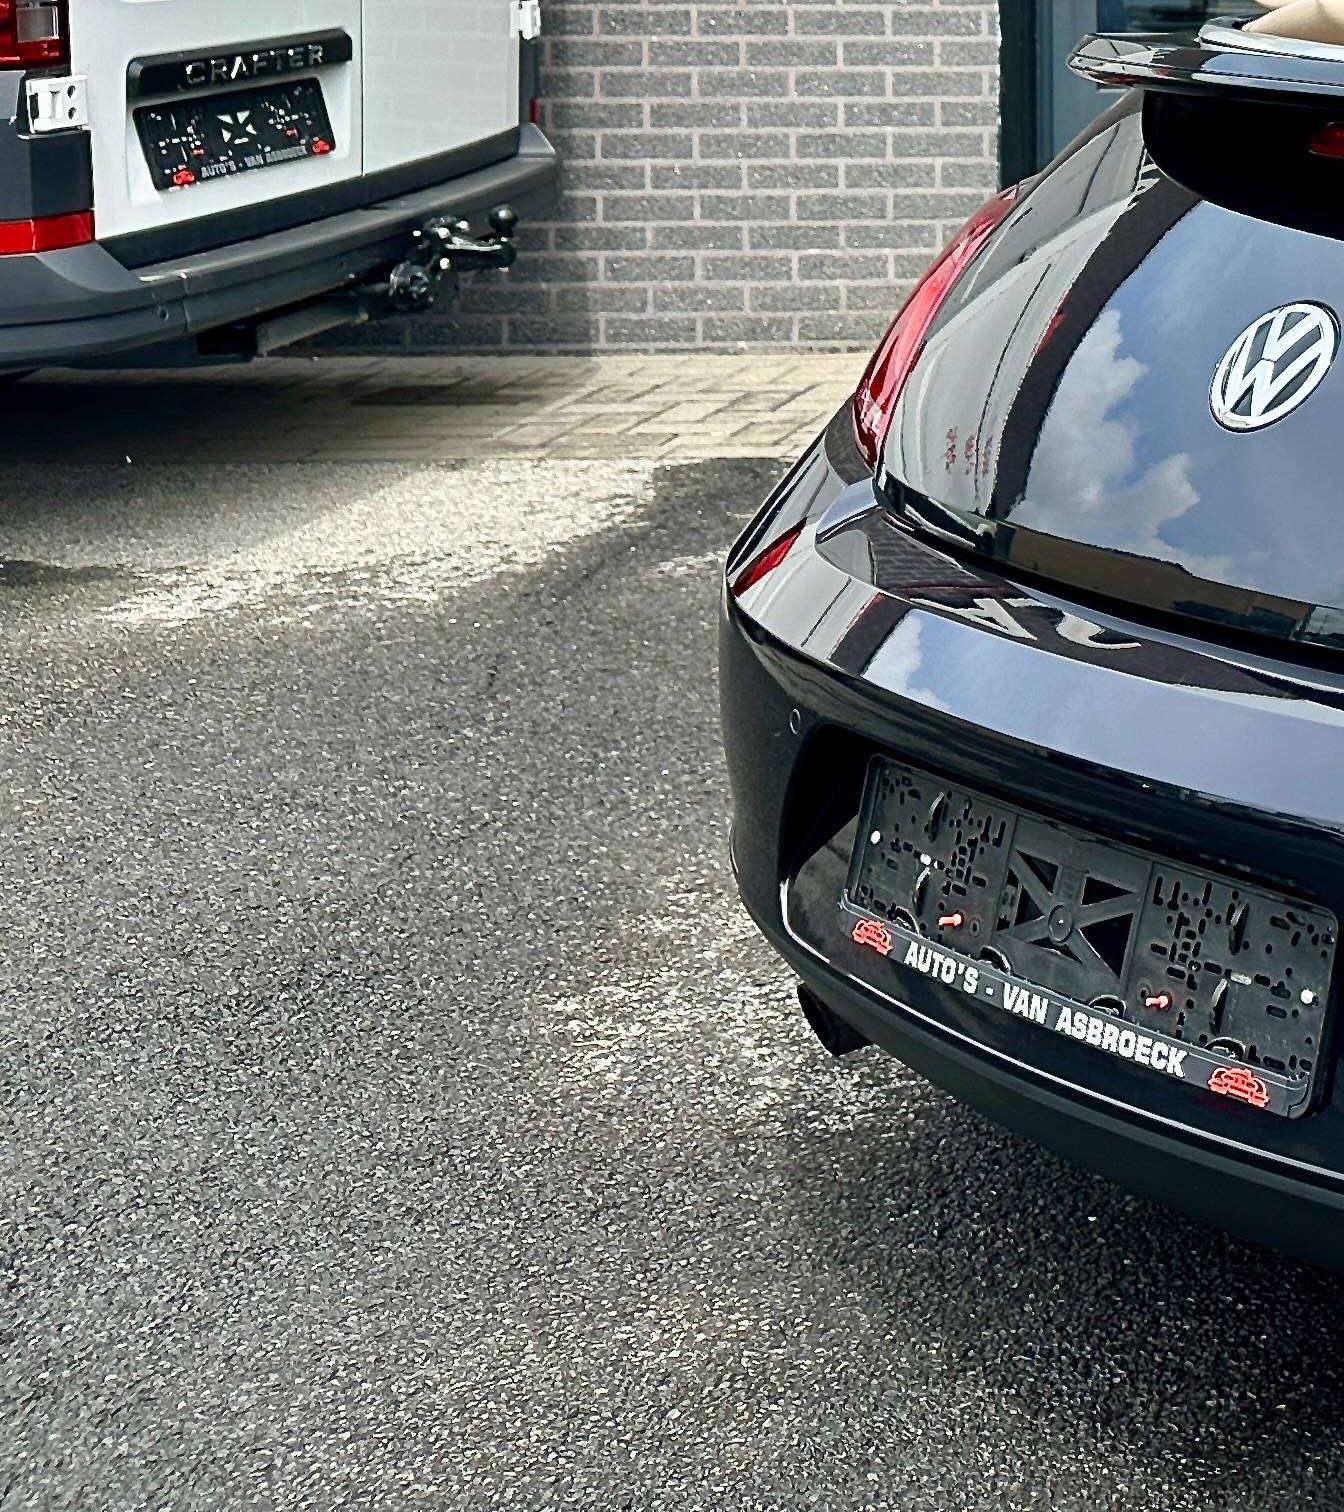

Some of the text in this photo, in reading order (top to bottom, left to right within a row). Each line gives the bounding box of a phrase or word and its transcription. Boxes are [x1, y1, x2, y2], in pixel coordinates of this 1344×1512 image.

[185, 43, 324, 85] CRAFTER
[902, 942, 979, 995] AUTO'S
[1002, 981, 1050, 1024] VAN
[1055, 1004, 1187, 1078] ASBROECK
